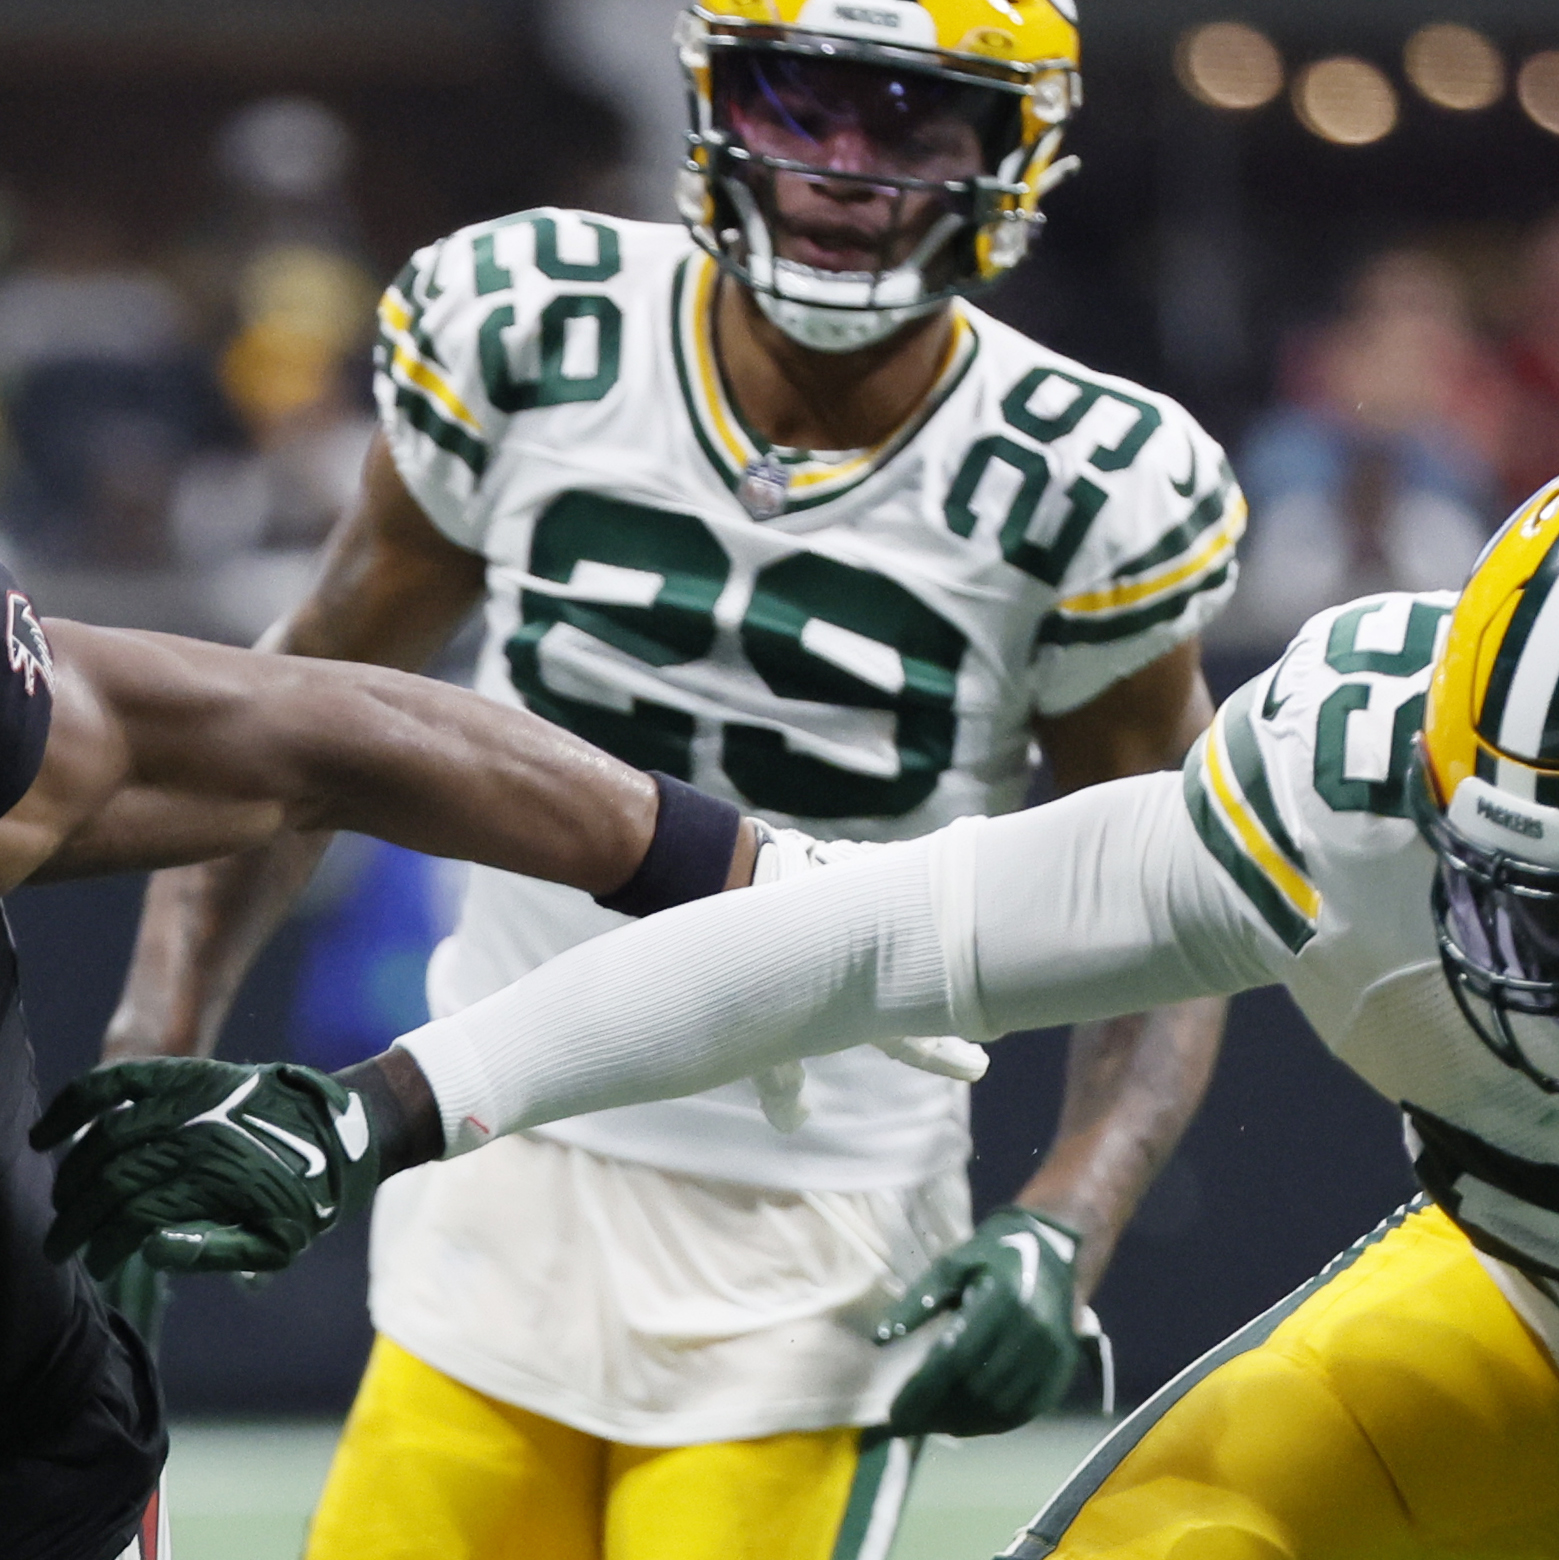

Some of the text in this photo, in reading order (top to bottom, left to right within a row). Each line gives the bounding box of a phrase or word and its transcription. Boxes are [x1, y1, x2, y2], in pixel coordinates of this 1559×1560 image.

[474, 211, 623, 412] 29
[943, 366, 1163, 588] 29
[505, 488, 971, 818] 29
[1476, 795, 1545, 840] PACKERS
